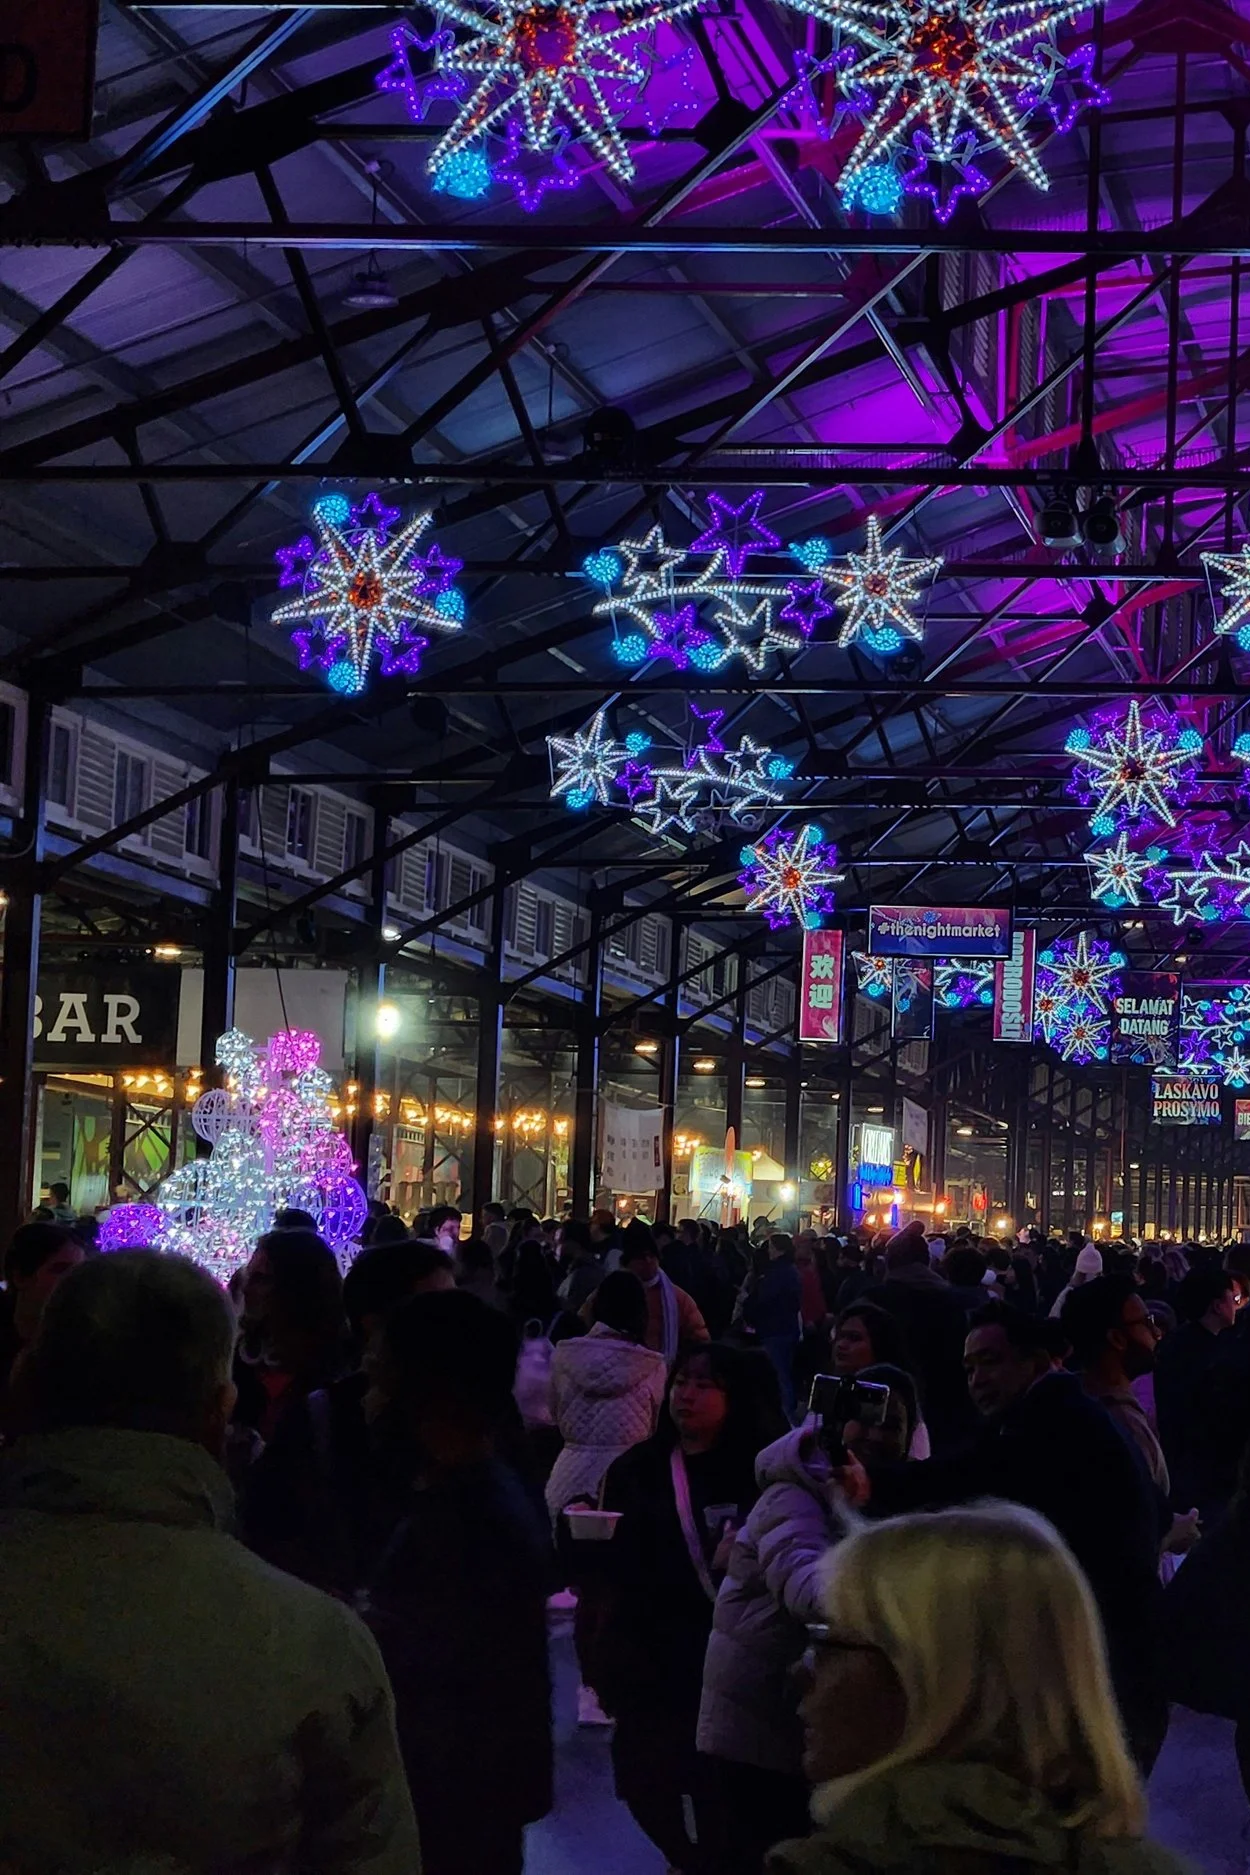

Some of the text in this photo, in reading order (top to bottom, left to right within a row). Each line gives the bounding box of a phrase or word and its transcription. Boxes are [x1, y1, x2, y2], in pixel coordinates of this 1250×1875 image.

[877, 922, 1000, 940] #thenightmarket
[1116, 997, 1175, 1016] SELAMAT
[33, 992, 143, 1044] AR
[1120, 1018, 1169, 1036] DATANG
[1154, 1082, 1219, 1100] LASKAVO
[1153, 1100, 1220, 1118] PROSYMO
